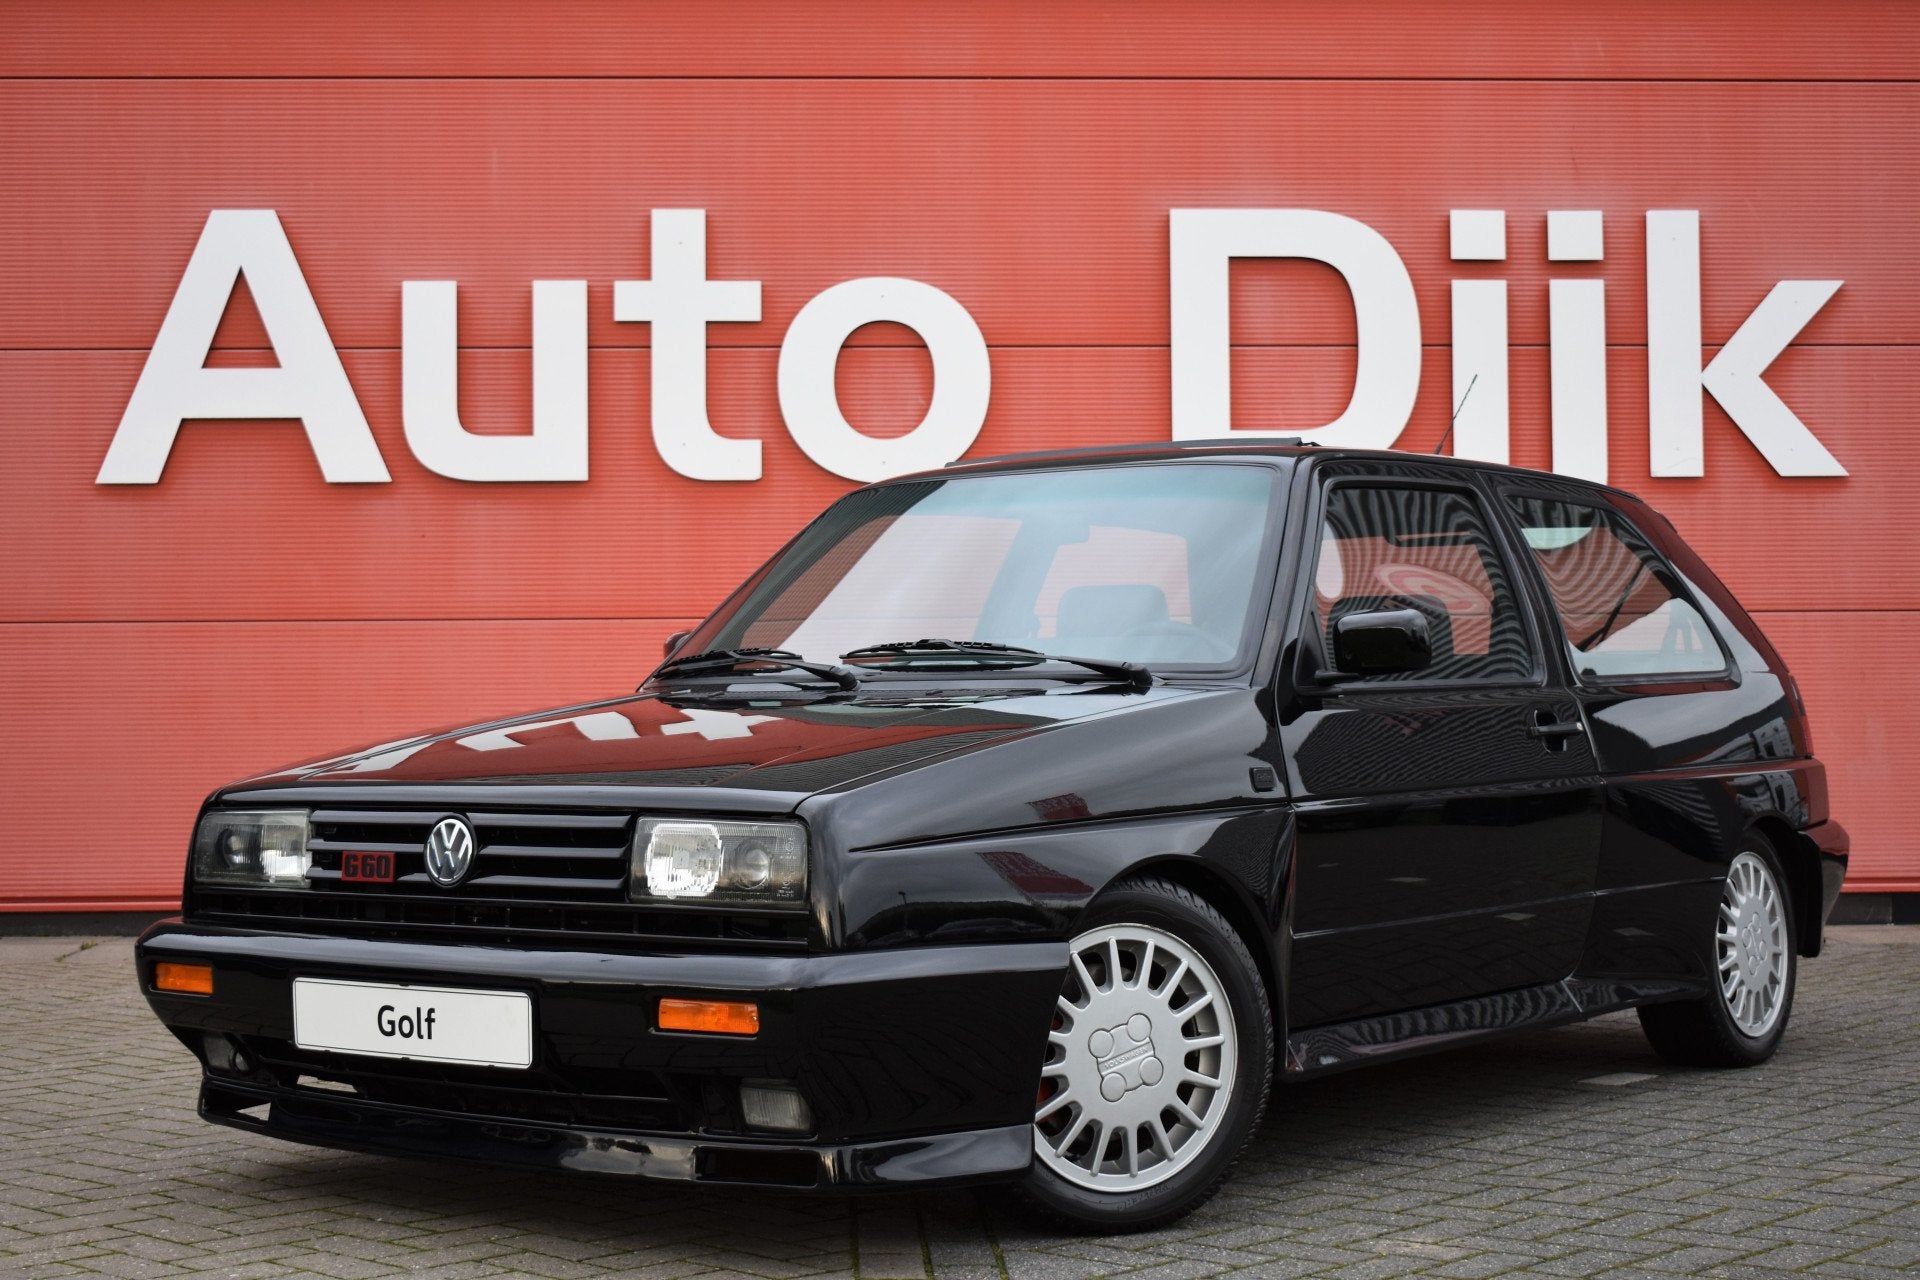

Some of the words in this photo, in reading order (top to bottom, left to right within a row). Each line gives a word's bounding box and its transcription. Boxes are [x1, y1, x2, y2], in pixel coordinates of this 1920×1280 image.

[95, 208, 992, 484] Auto
[1169, 208, 1850, 486] Dijk
[377, 1004, 436, 1040] Golf
